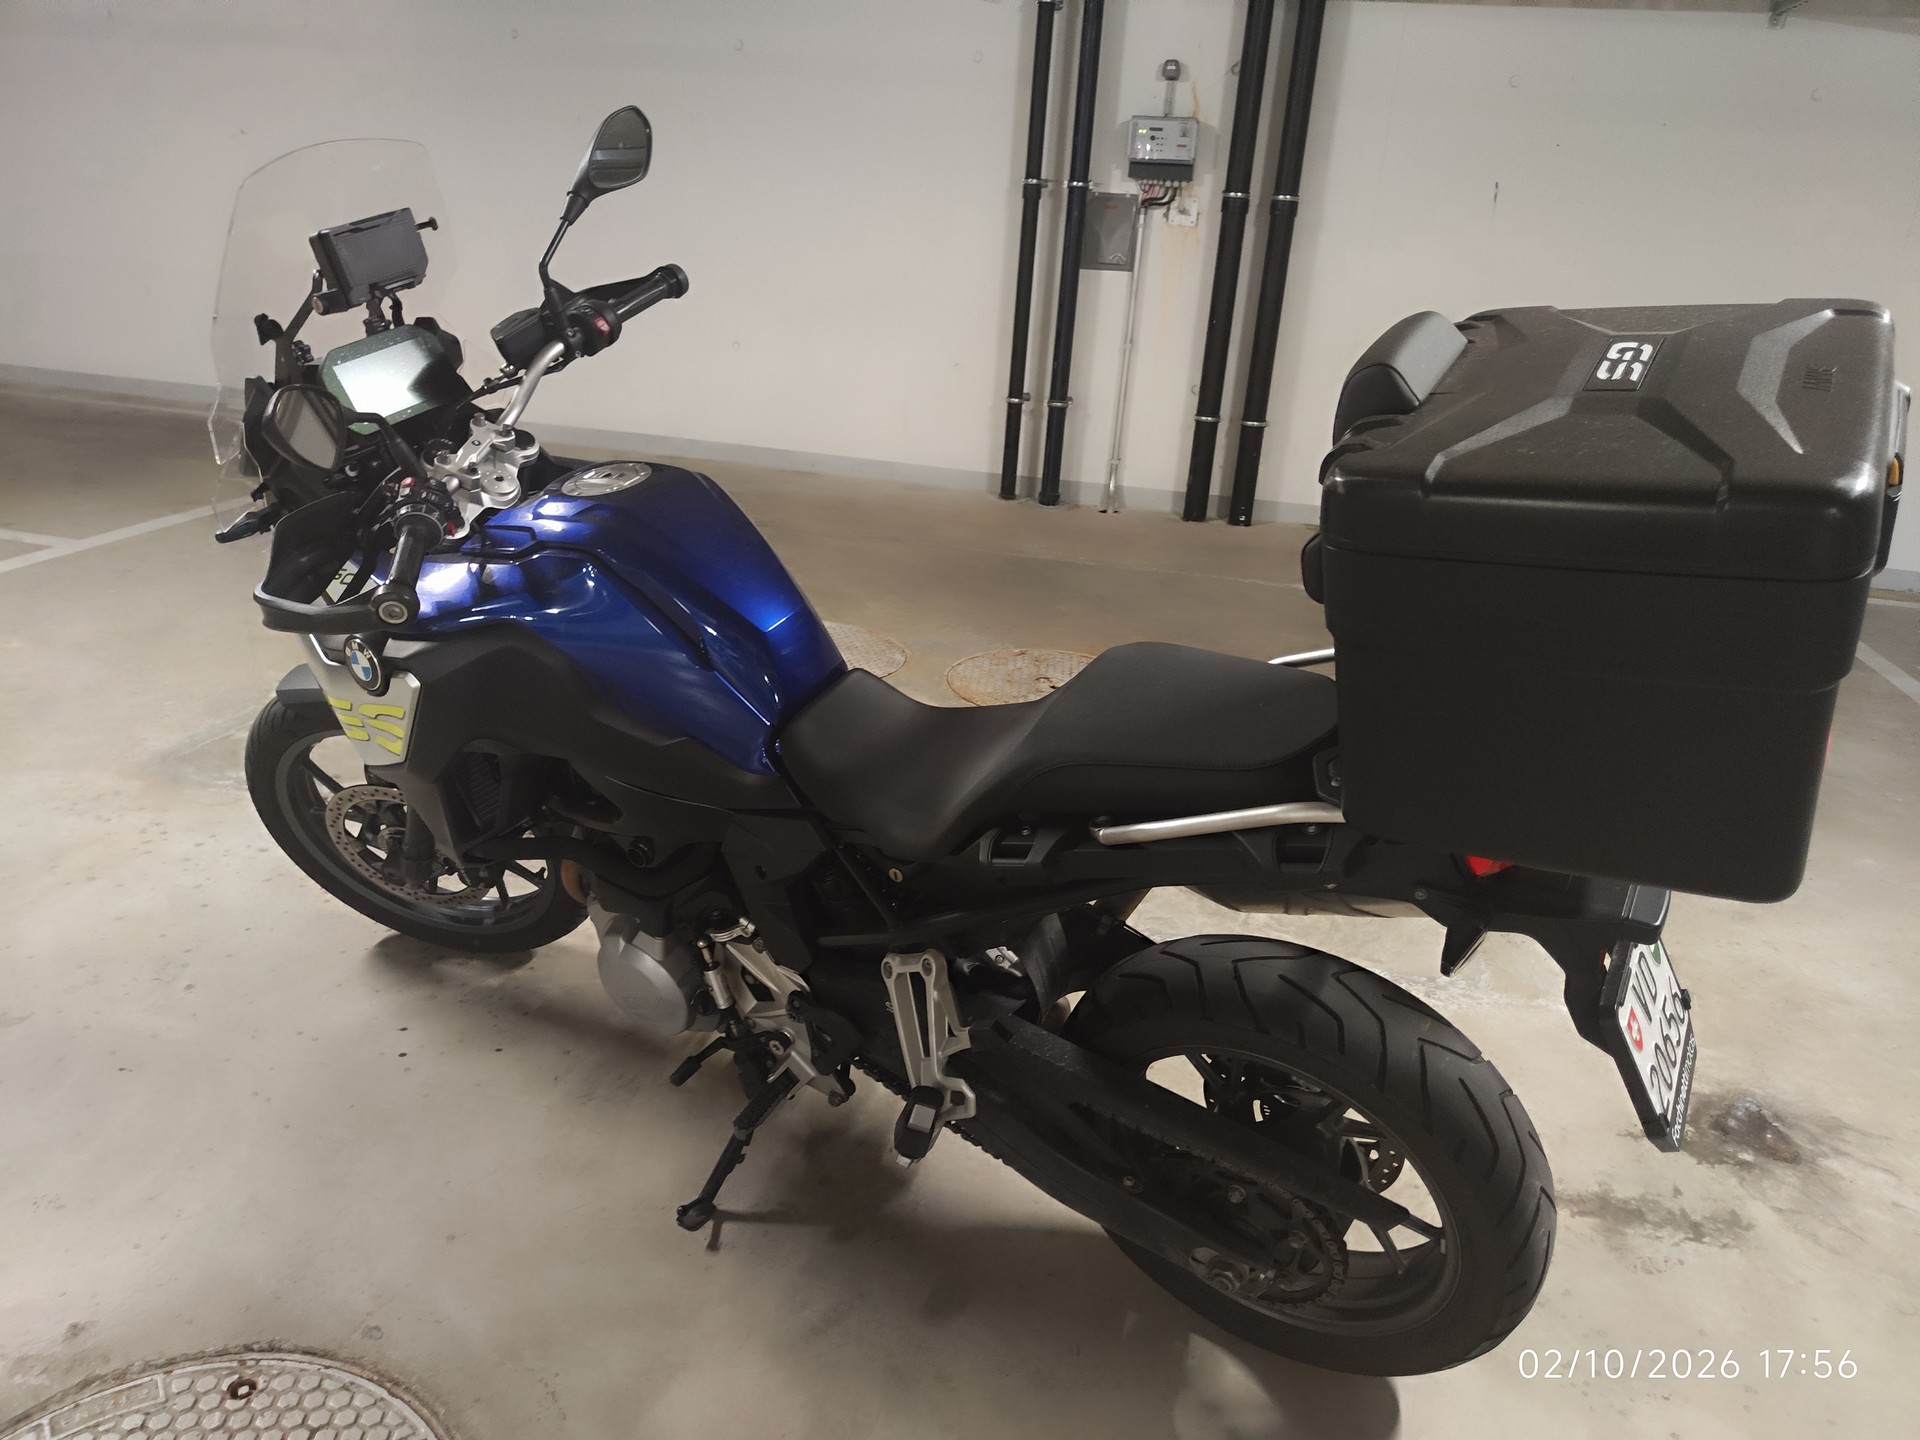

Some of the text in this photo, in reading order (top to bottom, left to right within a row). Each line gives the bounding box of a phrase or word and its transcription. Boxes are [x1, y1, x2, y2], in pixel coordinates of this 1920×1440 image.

[345, 641, 371, 659] BMW
[1632, 950, 1657, 1022] VD
[1650, 975, 1685, 1117] 20656
